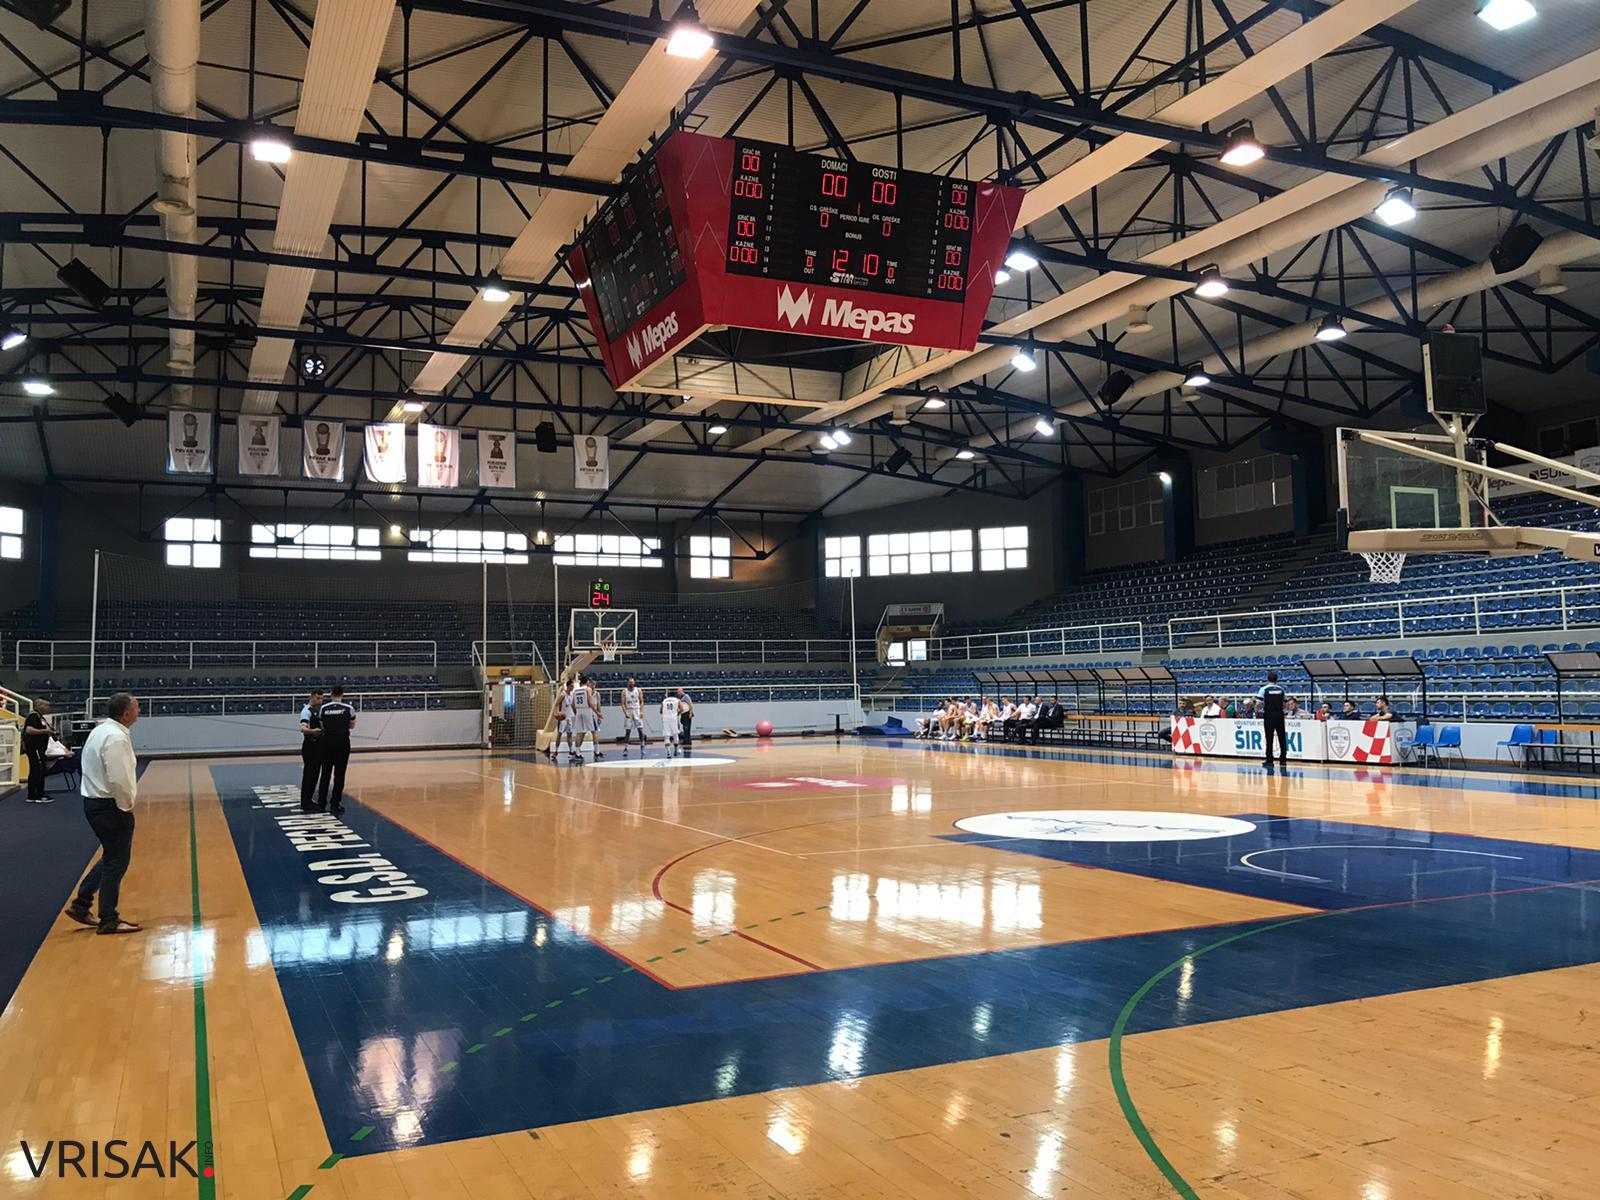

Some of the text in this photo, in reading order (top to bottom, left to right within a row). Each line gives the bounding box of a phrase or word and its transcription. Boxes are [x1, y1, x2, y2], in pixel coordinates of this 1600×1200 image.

[742, 154, 760, 171] 00
[740, 175, 759, 183] KAZNE
[872, 168, 897, 180] GOSTI
[821, 173, 848, 198] 00
[871, 181, 897, 205] 00
[737, 220, 755, 237] 00
[845, 232, 862, 240] BONUS
[832, 249, 880, 276] 12 10
[820, 298, 916, 339] Mepas
[641, 311, 679, 353] Mepas
[592, 591, 609, 606] 24
